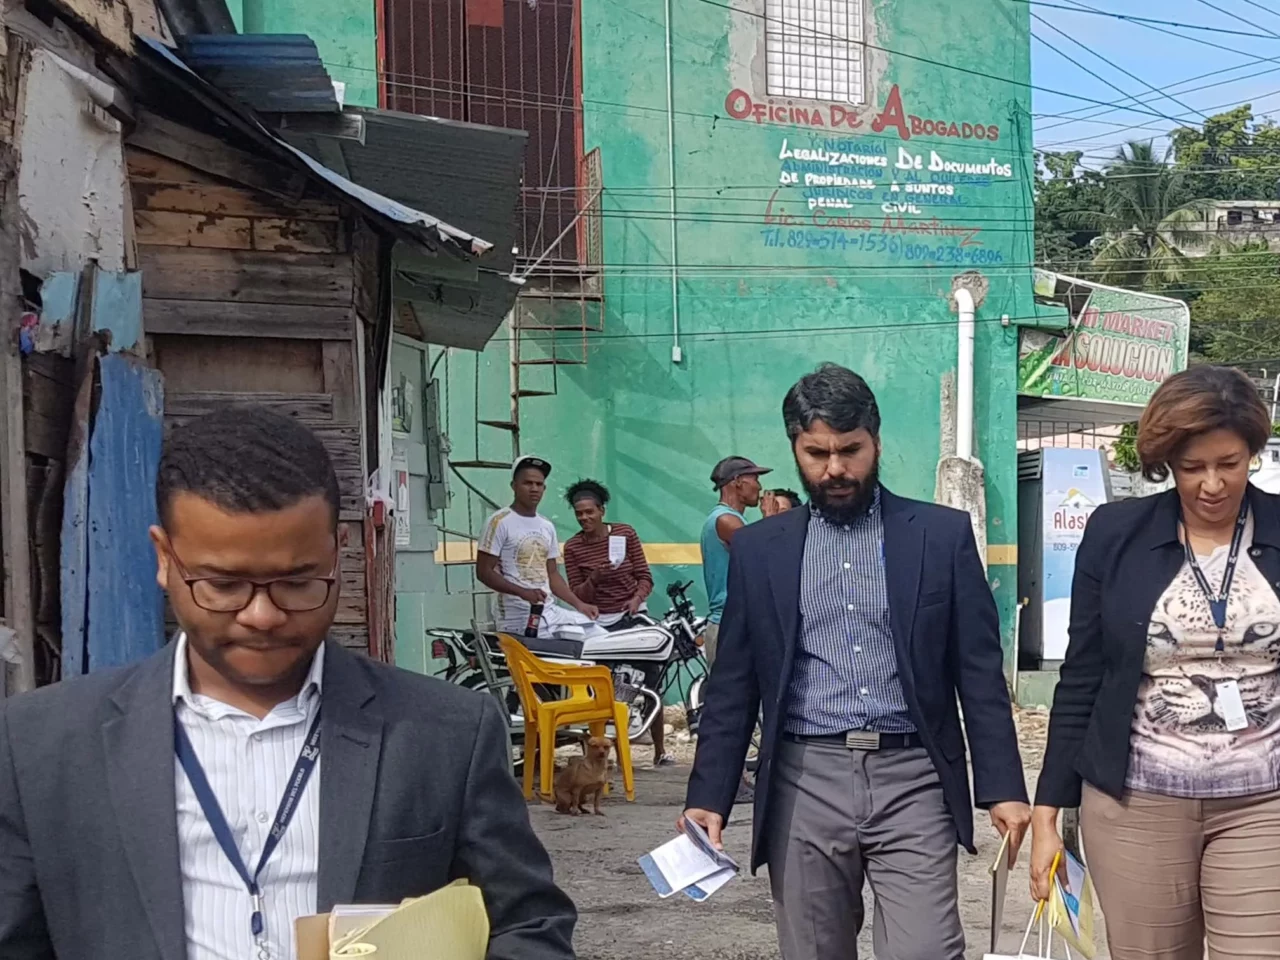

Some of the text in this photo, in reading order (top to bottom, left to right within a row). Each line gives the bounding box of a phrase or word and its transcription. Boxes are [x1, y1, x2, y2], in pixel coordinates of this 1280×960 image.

[725, 88, 824, 124] OFICINA
[872, 84, 999, 141] ABOGADOS
[1103, 312, 1176, 342] MARKET
[1074, 331, 1174, 384] SOLUCION
[1054, 509, 1089, 530] Alas
